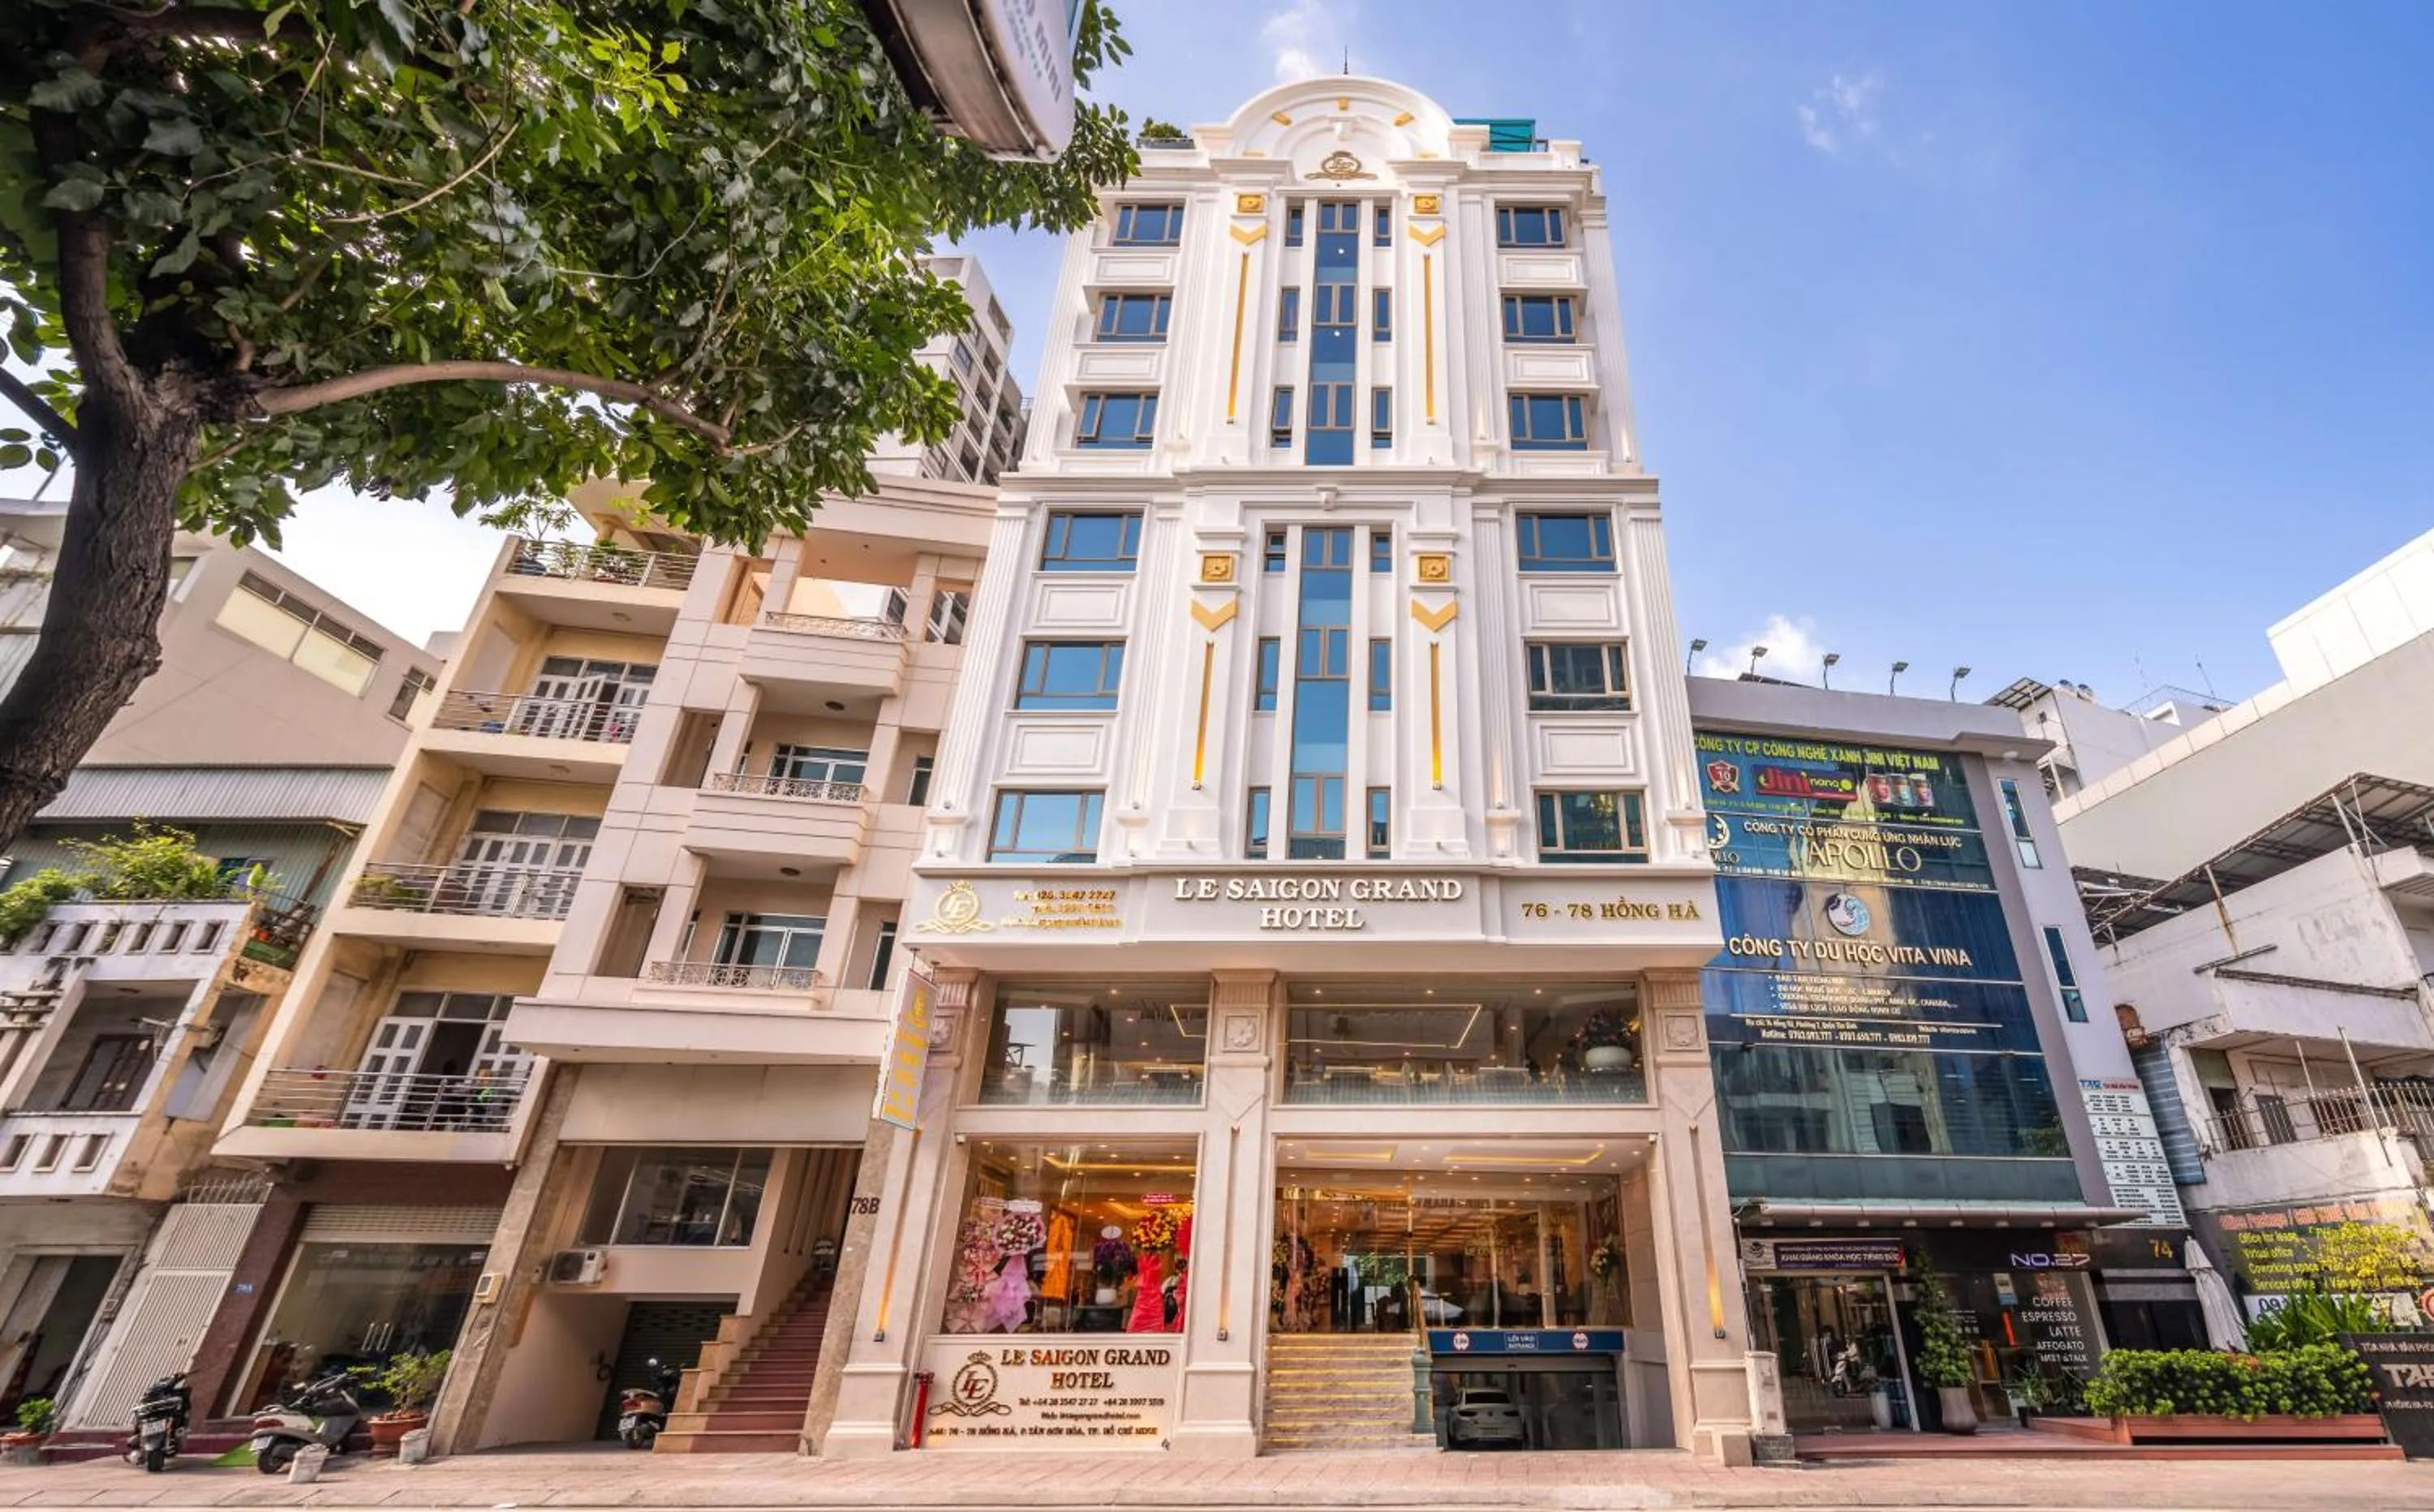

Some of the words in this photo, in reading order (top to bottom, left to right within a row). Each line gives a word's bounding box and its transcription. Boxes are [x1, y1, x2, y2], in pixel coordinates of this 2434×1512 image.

[1726, 739, 1741, 753] TY
[1745, 741, 1760, 755] CP
[1763, 740, 1795, 757] CÔNG
[1830, 748, 1862, 763] XANH
[1912, 755, 1940, 771] NAM
[1744, 819, 1778, 833] CÔNG
[1779, 823, 1795, 834] TY
[1808, 840, 1922, 872] APOLLO
[1175, 878, 1218, 900] LE
[1226, 878, 1343, 900] SAIGON
[1349, 878, 1463, 901] GRAND
[1521, 903, 1548, 918] 76
[1567, 903, 1593, 918] 78
[1600, 896, 1660, 919] HỒNG
[1666, 900, 1701, 919] HÀ
[1259, 907, 1365, 930] HOTEL
[1729, 934, 1782, 957] CÔNG
[1787, 939, 1811, 958] TY
[1814, 941, 1841, 960] DU
[1843, 942, 1883, 966] HỌC
[1885, 946, 1929, 965] VITA
[1929, 947, 1973, 966] VINA
[852, 1197, 880, 1214] 78B
[2010, 1253, 2091, 1266] NO.27
[2032, 1296, 2075, 1308] COFFEE
[2021, 1310, 2078, 1323] ESPRESSO
[2049, 1325, 2082, 1338] LATTE
[2036, 1341, 2085, 1351] AFFOGATO
[1000, 1349, 1026, 1366] LE
[1030, 1349, 1100, 1366] SAIGON
[1104, 1349, 1171, 1366] GRAND
[1051, 1372, 1115, 1390] HOTEL
